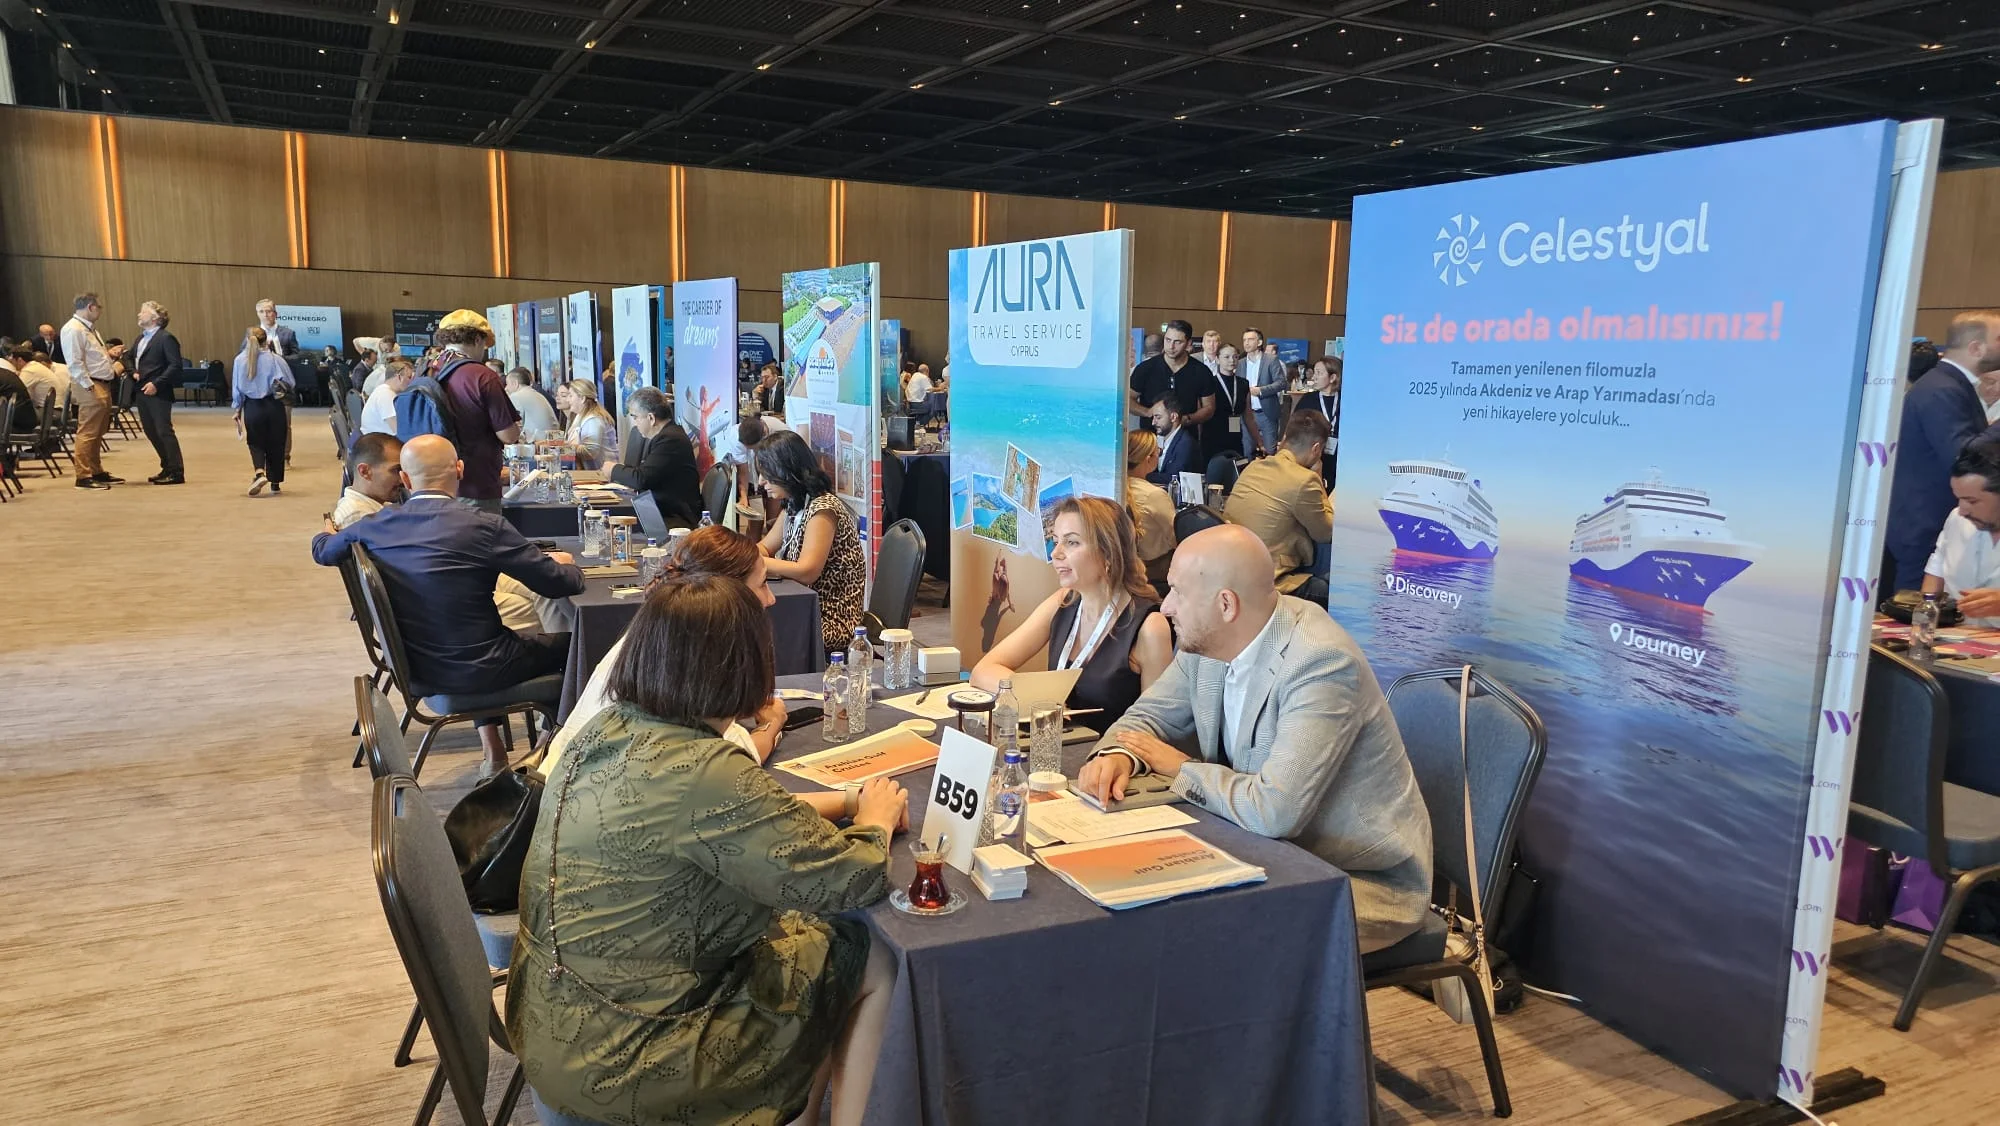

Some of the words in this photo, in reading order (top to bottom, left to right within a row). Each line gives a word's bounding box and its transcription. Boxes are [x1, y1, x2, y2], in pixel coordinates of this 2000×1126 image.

[1499, 202, 1709, 272] Celestyal
[973, 240, 1086, 314] AURA
[692, 300, 713, 316] CARRIER
[714, 299, 722, 316] OF
[683, 316, 720, 349] dreams
[973, 325, 1017, 339] TRAVEL
[1024, 324, 1082, 339] SERVICE
[1380, 313, 1417, 344] Siz
[1423, 313, 1457, 343] de
[1463, 308, 1551, 341] orada
[1558, 301, 1784, 341] olmalısınız!
[1011, 345, 1039, 357] CYPRUS
[1450, 361, 1512, 376] Tamamen
[1514, 361, 1582, 378] yenilenen
[1585, 362, 1656, 379] filomuzla
[1409, 381, 1438, 395] 2025
[1440, 383, 1478, 399] yılında
[1480, 384, 1533, 399] Akdeniz
[1535, 387, 1551, 399] ve
[1554, 385, 1590, 404] Arap
[1462, 406, 1489, 422] yeni
[1491, 406, 1557, 424] hikayelere
[1559, 410, 1630, 428] yolculuk...
[1395, 576, 1462, 609] Discovery
[1623, 628, 1706, 668] Journey
[934, 773, 978, 820] B59
[1164, 853, 1216, 867] Arabian
